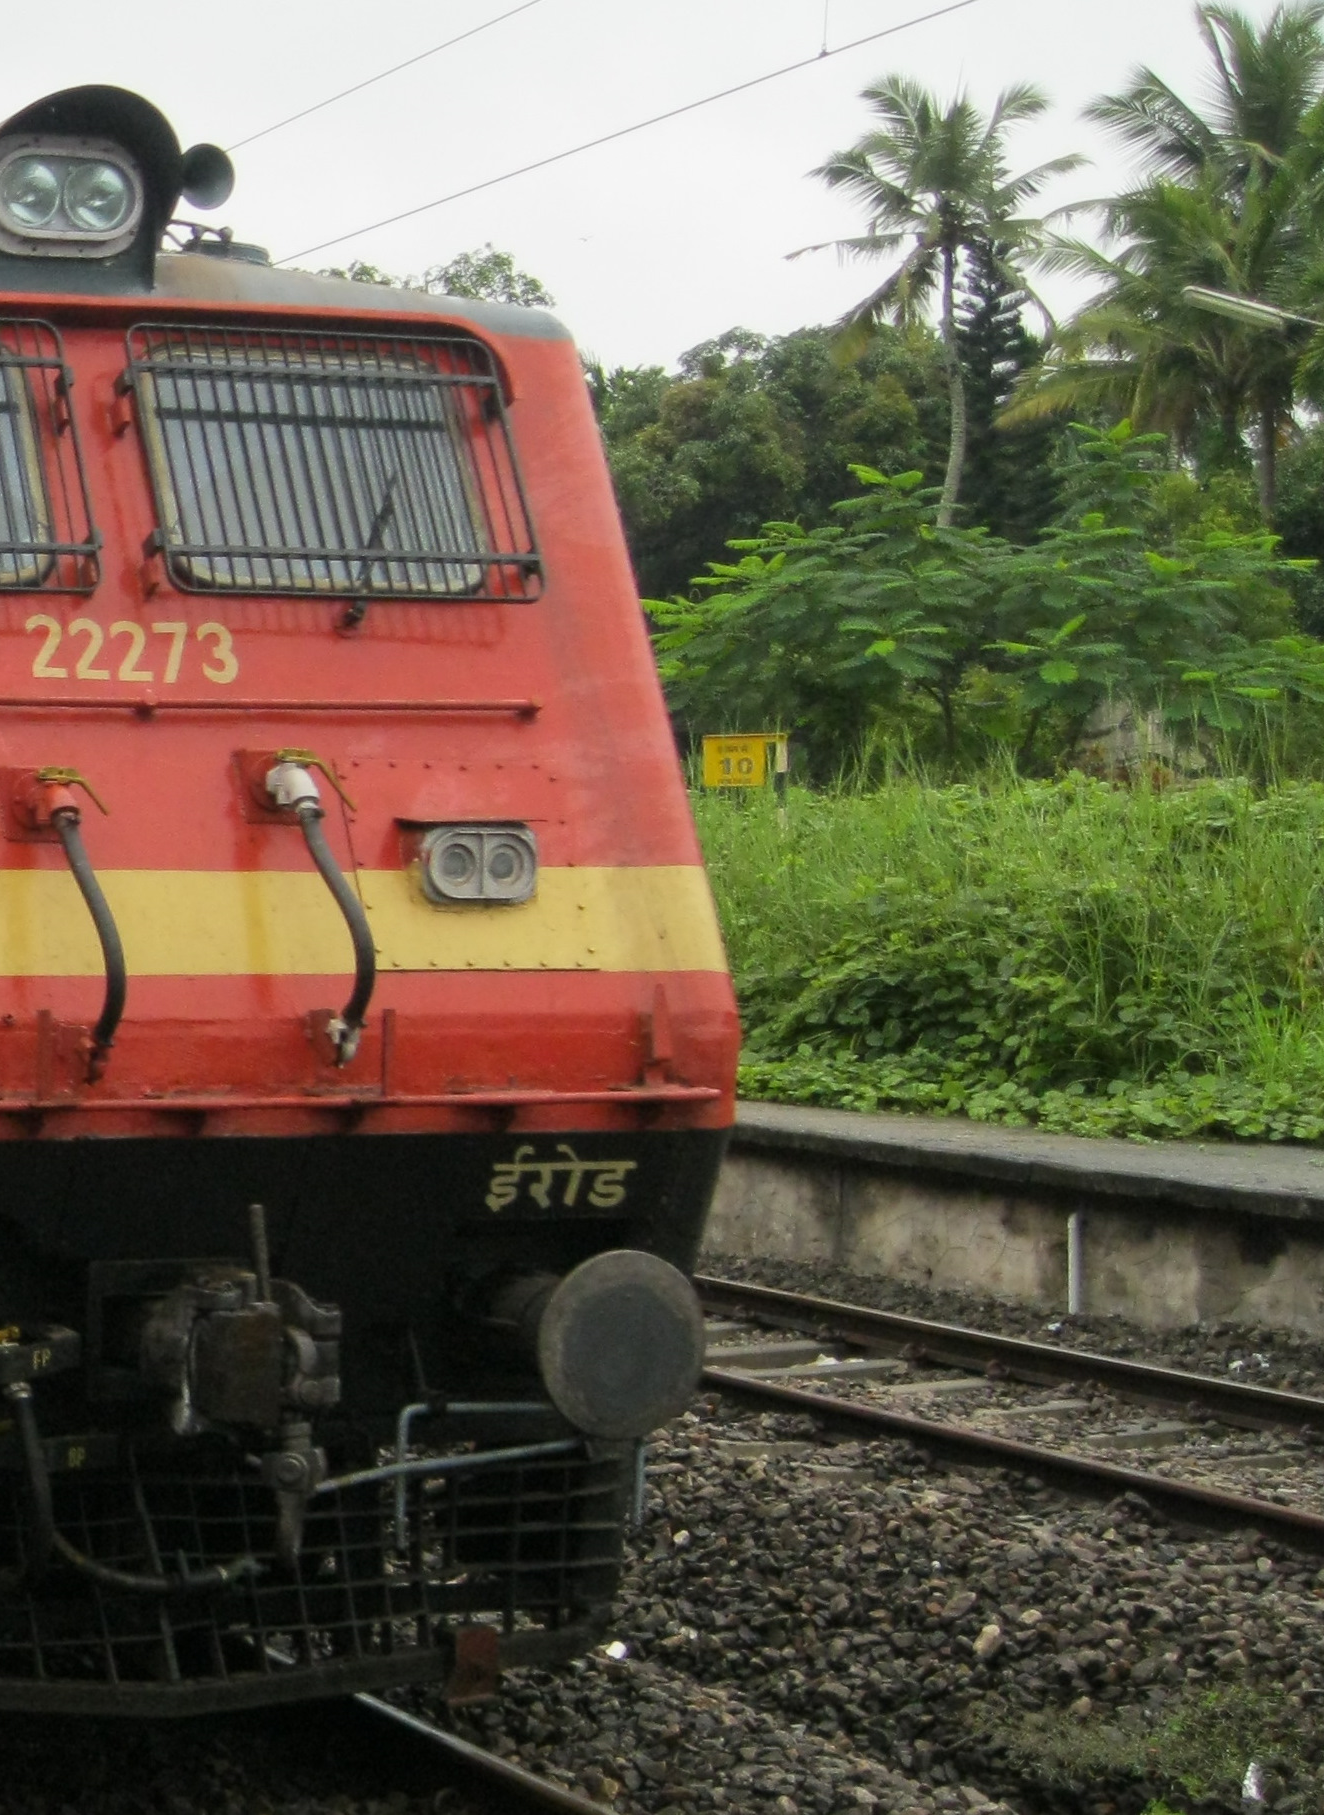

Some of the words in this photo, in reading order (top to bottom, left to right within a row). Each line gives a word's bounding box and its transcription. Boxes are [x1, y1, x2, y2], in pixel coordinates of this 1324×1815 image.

[26, 614, 239, 684] 22273
[719, 757, 754, 775] 10
[485, 1144, 638, 1212] ईरोड
[33, 1348, 51, 1371] FP
